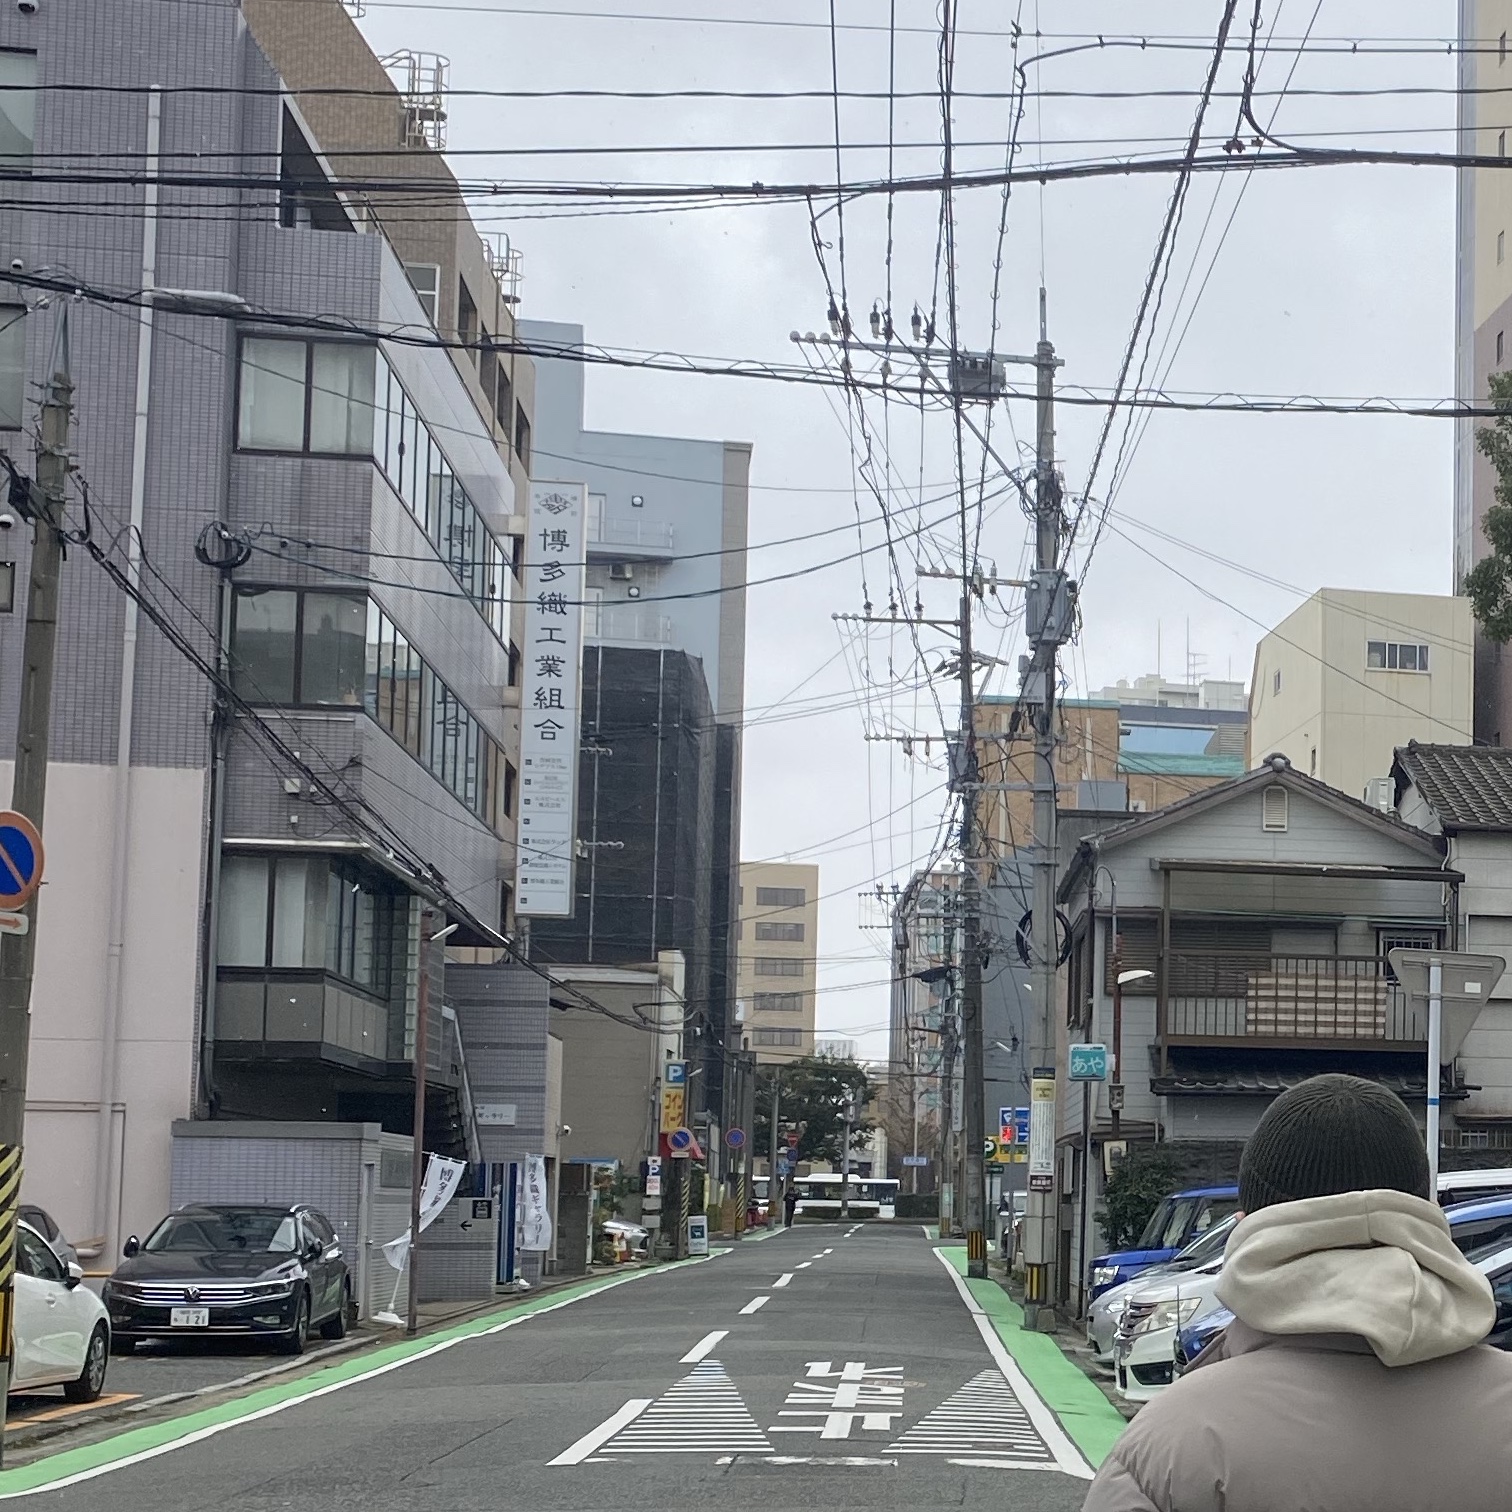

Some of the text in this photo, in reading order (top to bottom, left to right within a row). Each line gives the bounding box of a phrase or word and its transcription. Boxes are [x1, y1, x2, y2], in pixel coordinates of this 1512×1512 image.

[533, 528, 570, 741] 博多織工業組合
[1072, 1055, 1104, 1074] あや
[668, 1066, 682, 1082] P
[664, 1092, 683, 1110] コイン
[663, 1112, 683, 1127] パーク
[648, 1165, 660, 1176] P
[767, 1361, 905, 1439] 止まれ
